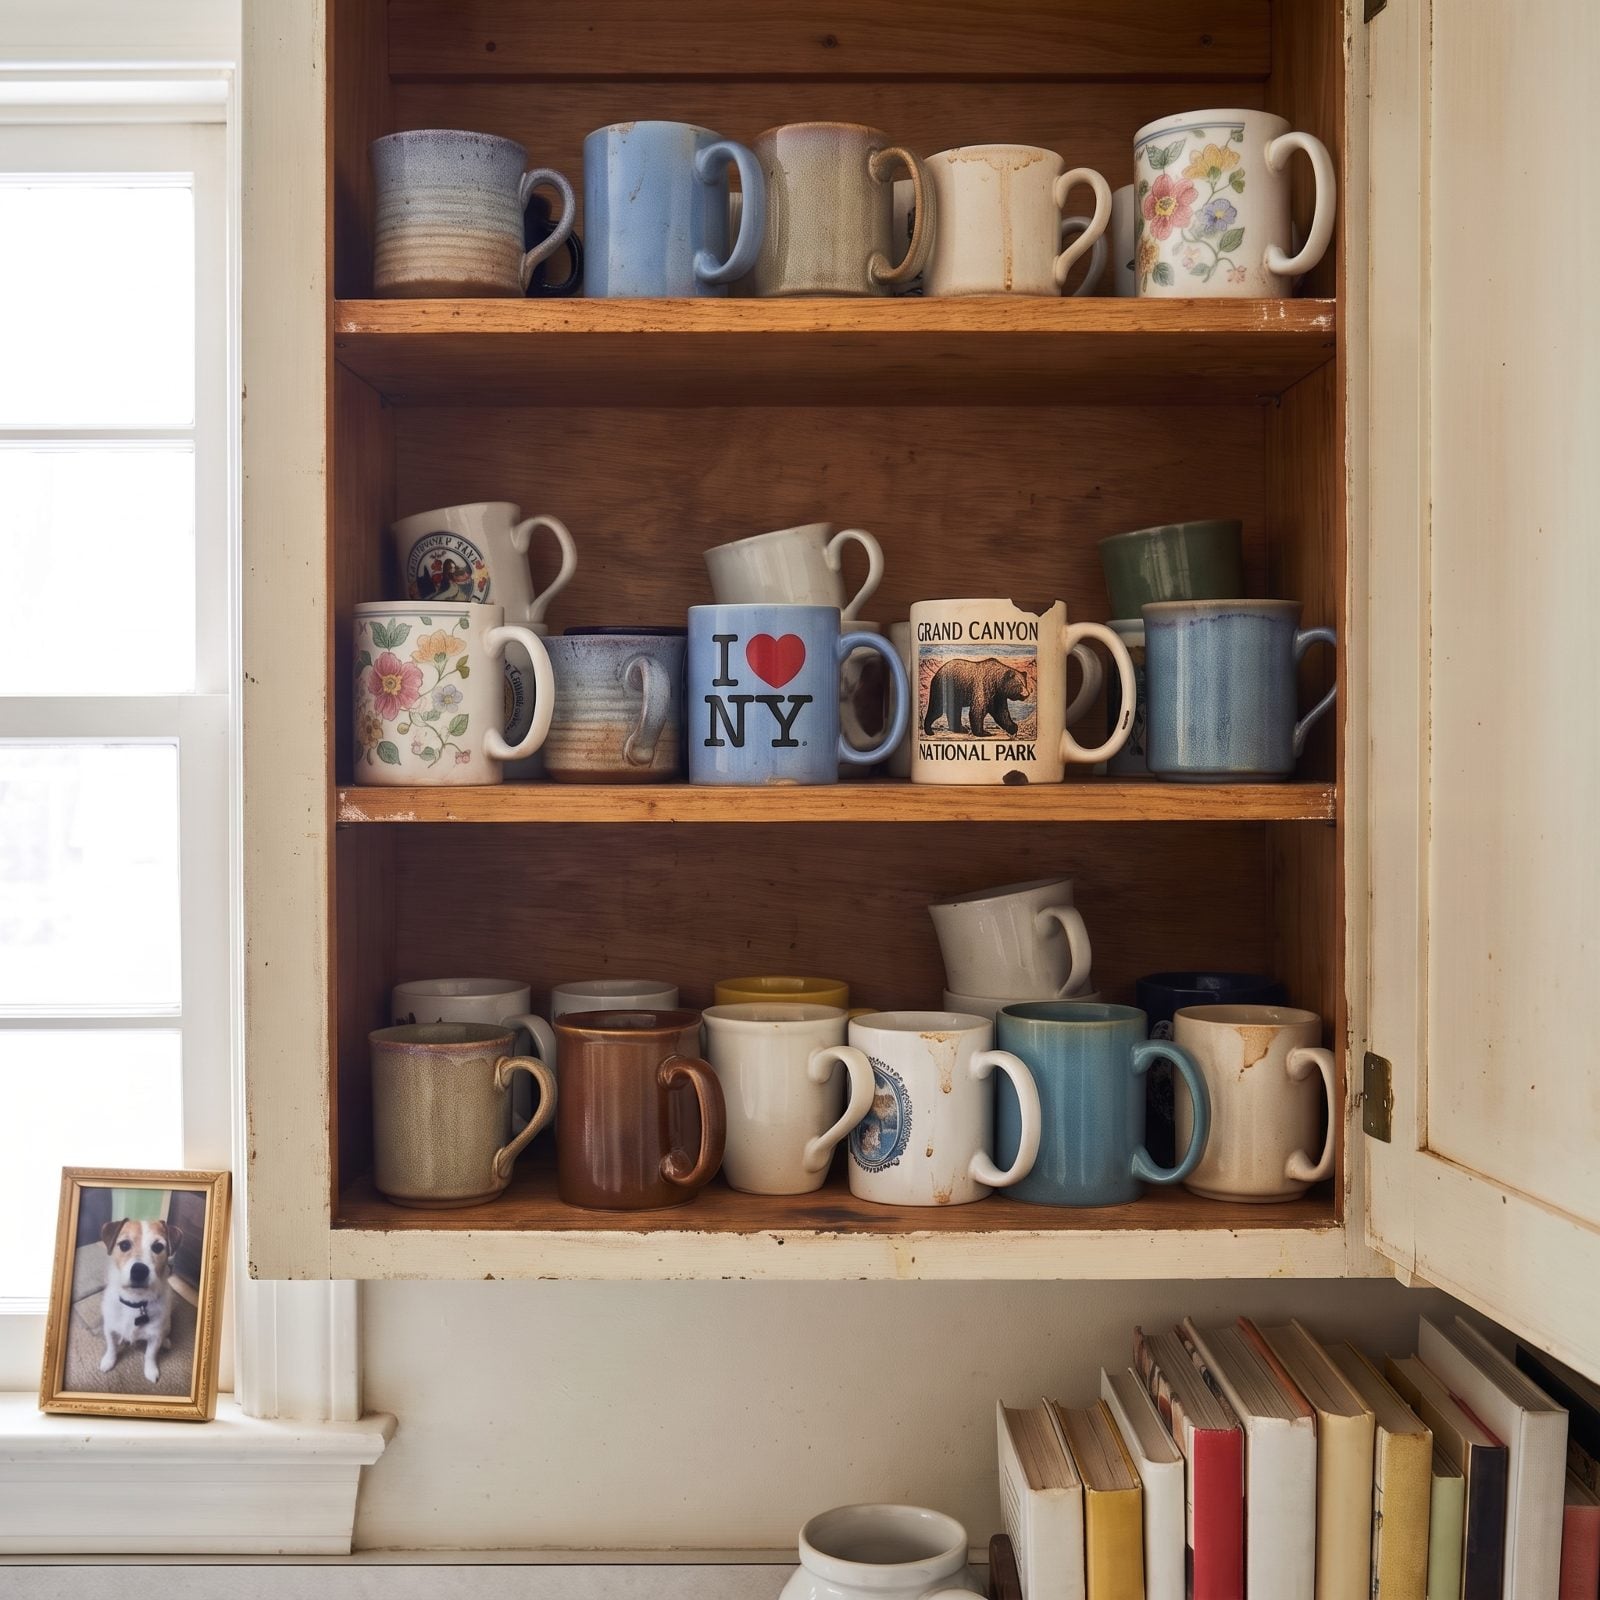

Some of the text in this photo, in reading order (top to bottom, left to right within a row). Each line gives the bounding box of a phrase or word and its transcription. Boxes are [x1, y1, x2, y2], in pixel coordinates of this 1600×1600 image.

[917, 621, 1039, 642] GRAND CANYON
[712, 634, 738, 687] I
[919, 743, 1037, 761] NATIONAL PARK
